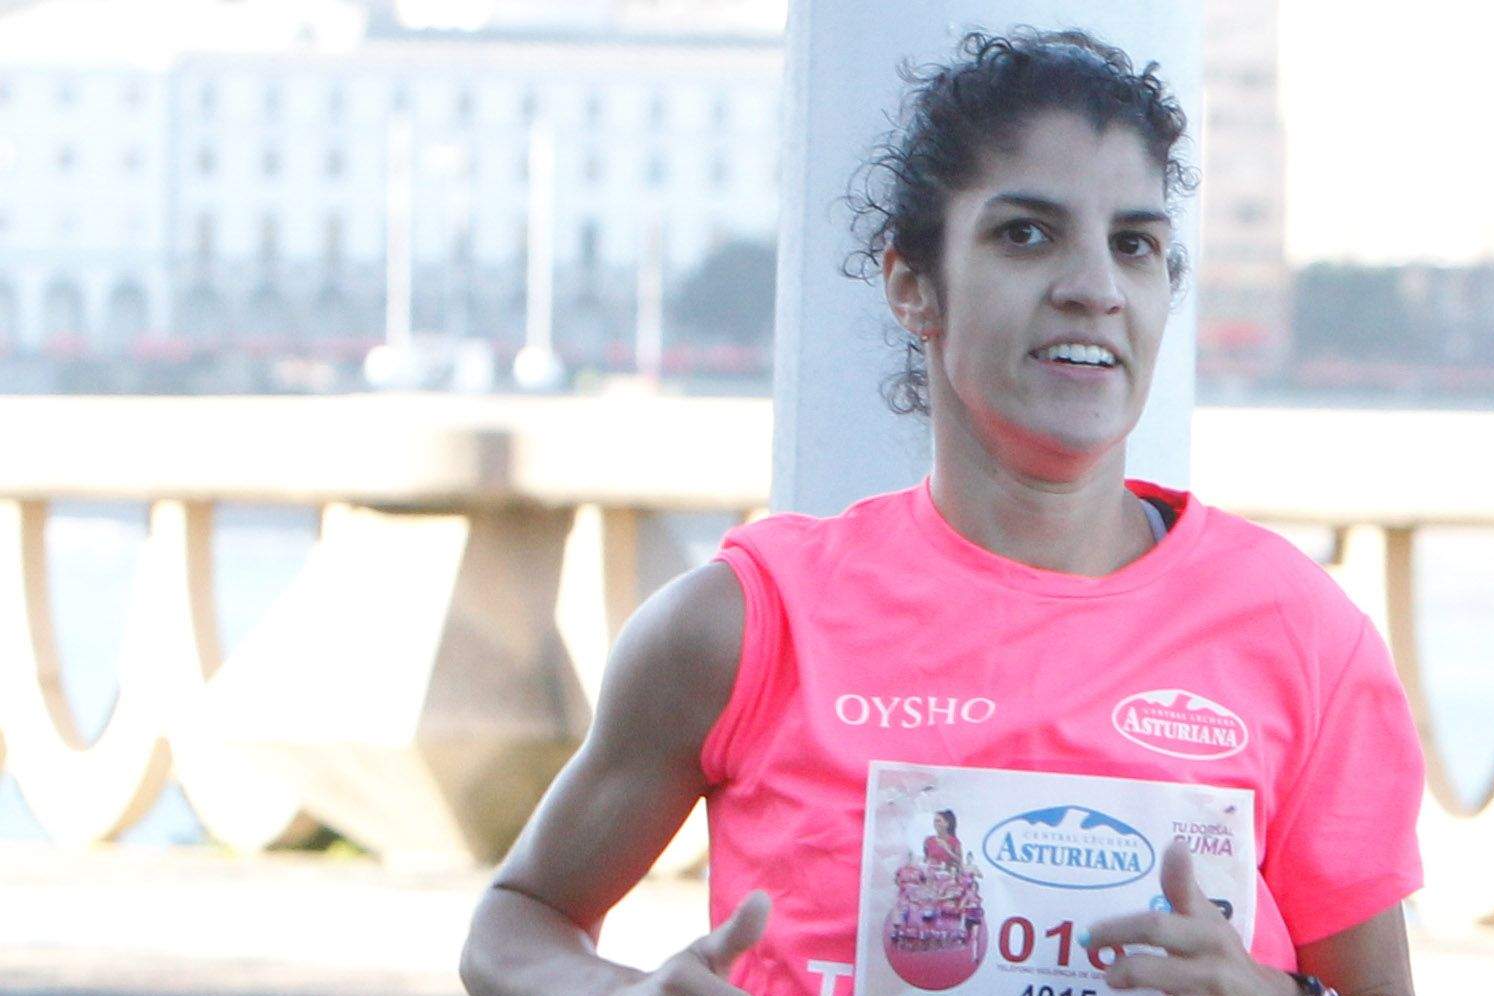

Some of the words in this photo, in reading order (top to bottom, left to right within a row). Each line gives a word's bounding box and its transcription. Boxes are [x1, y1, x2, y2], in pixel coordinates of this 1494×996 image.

[835, 693, 997, 729] OYSHO
[1122, 706, 1237, 748] ASTURIANA
[996, 831, 1143, 873] ASTURIANA
[1173, 833, 1234, 856] UMA
